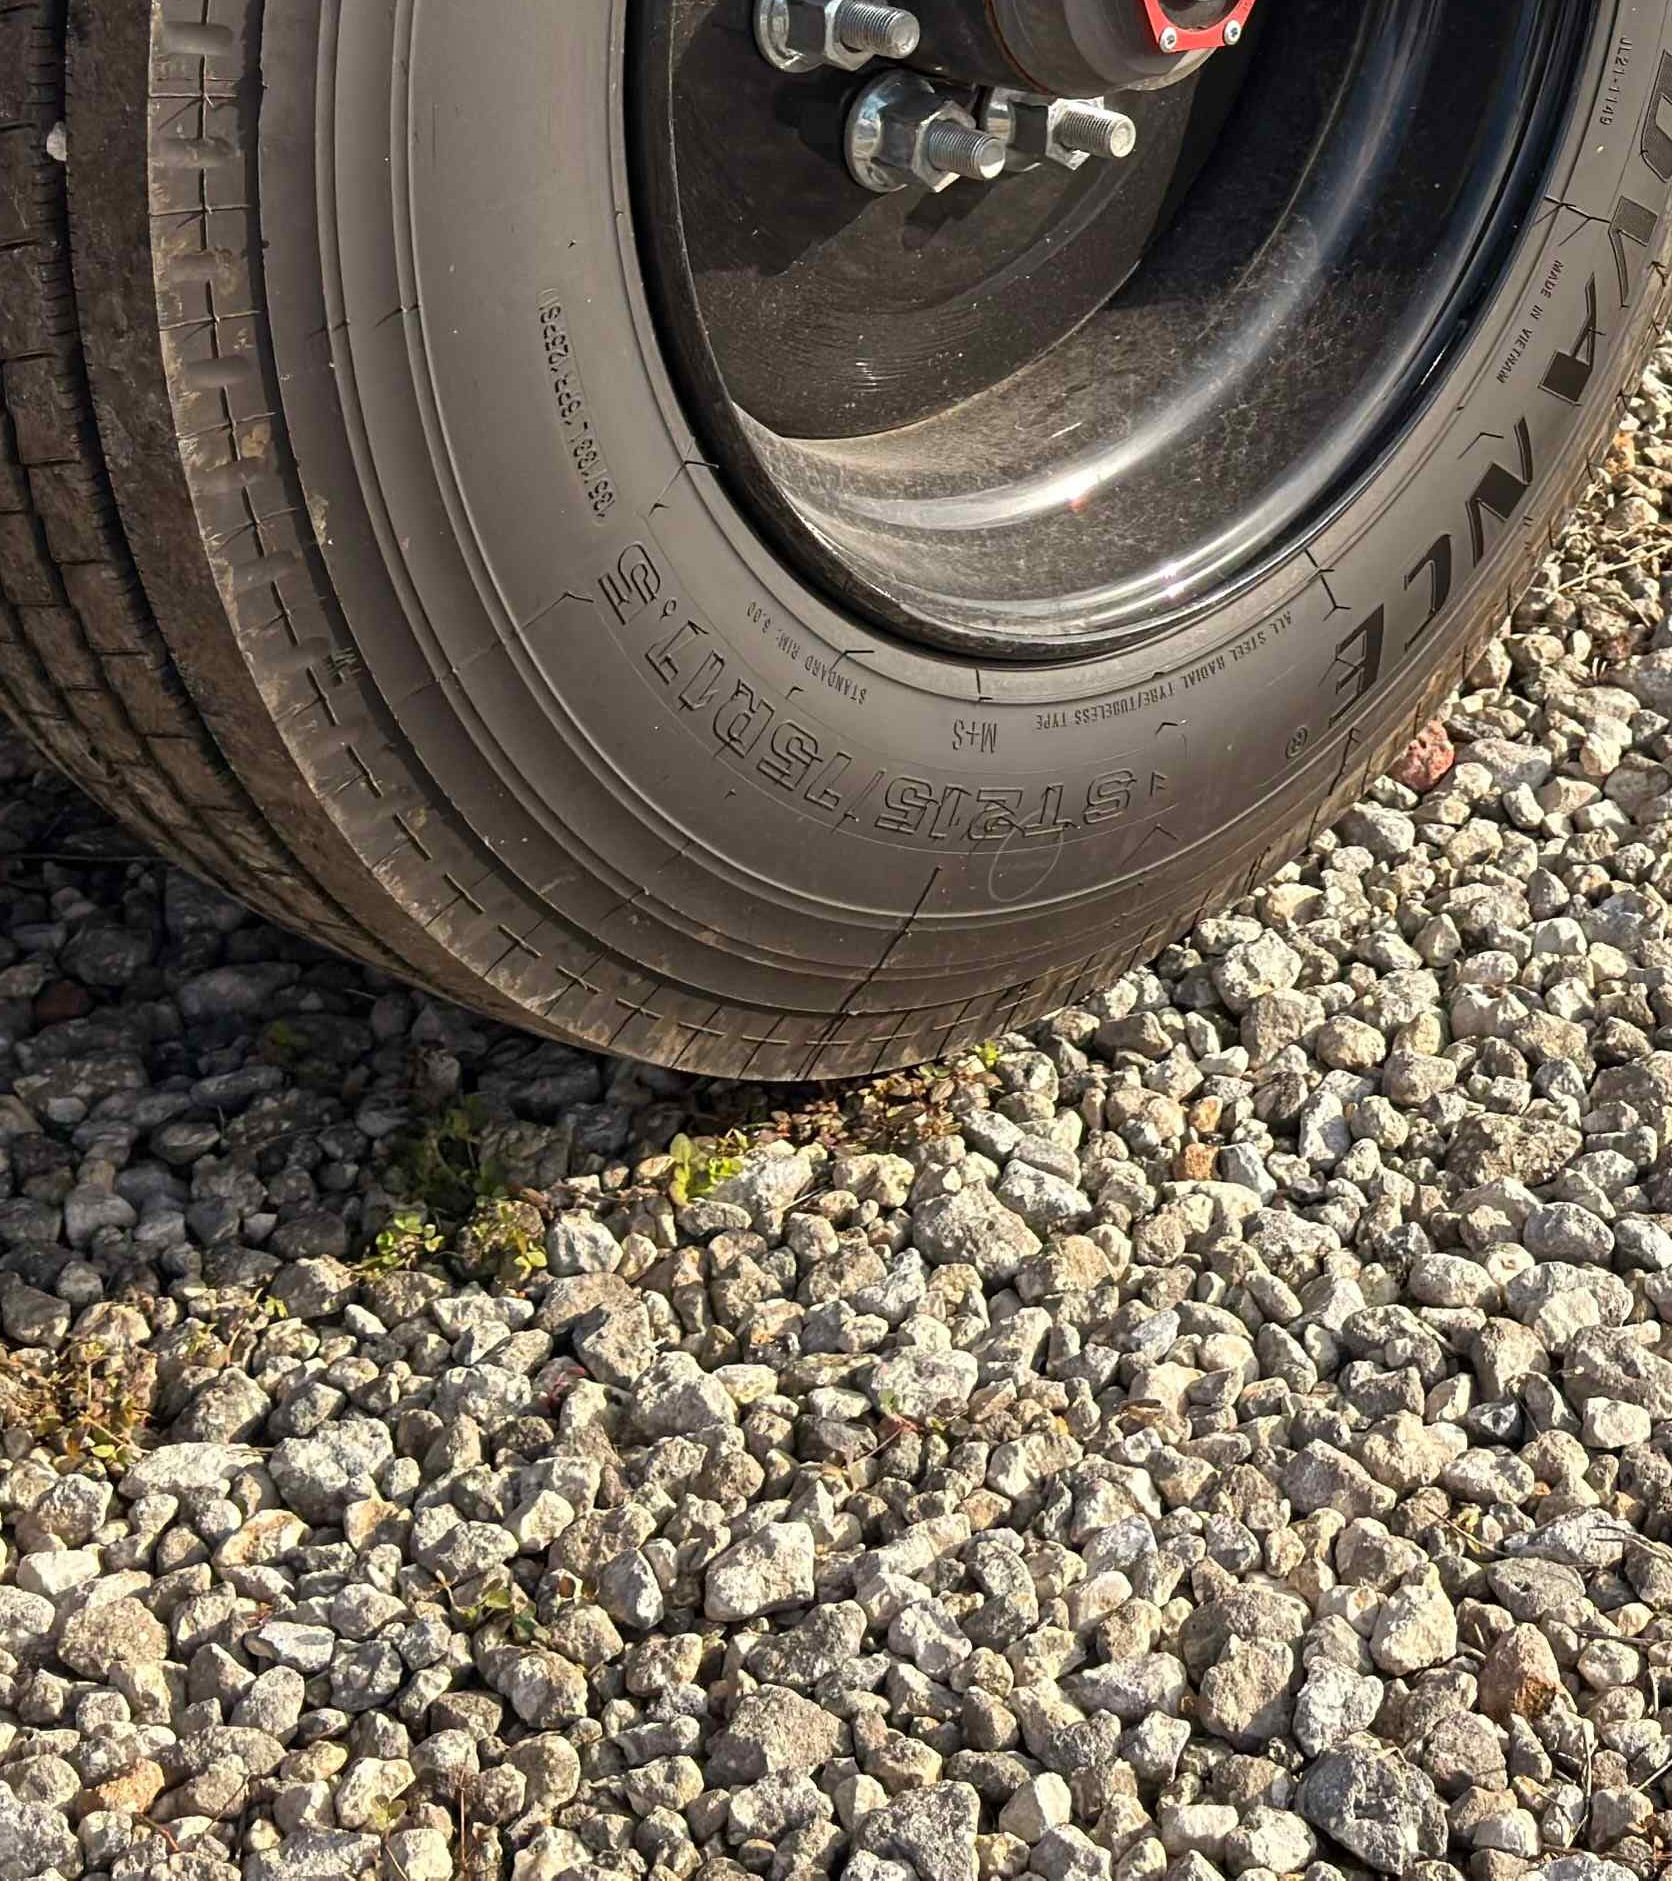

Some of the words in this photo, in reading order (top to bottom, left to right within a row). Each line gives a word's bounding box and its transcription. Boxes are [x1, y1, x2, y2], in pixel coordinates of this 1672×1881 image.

[1539, 259, 1563, 298] MADE
[1529, 305, 1543, 320] IN
[1495, 330, 1532, 384] VIETNAM
[1269, 610, 1294, 634] ALL
[1227, 630, 1267, 661] STEEL
[802, 653, 867, 704] STANDARD
[1179, 655, 1226, 689] RADIAL
[597, 542, 1134, 840] ST215/75R17.5
[952, 718, 997, 754] M+S
[1035, 711, 1068, 729] TYPE
